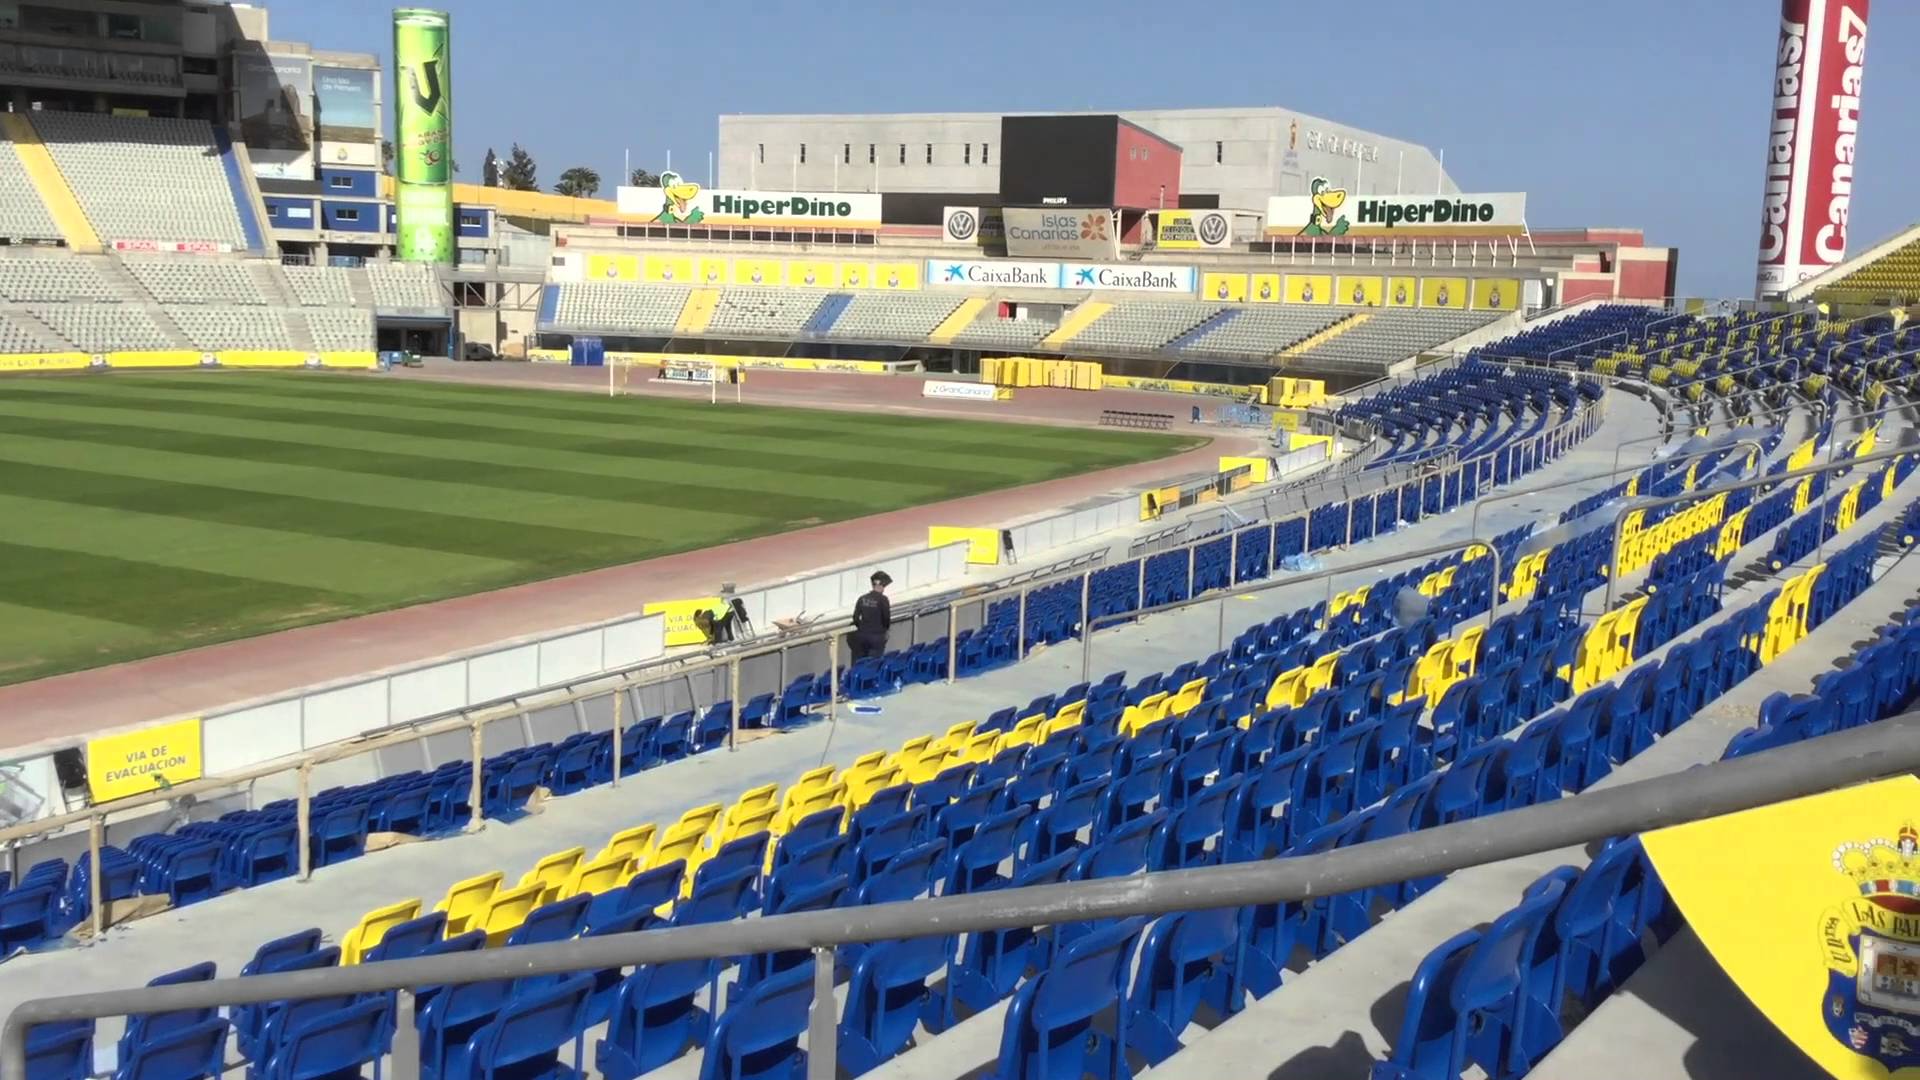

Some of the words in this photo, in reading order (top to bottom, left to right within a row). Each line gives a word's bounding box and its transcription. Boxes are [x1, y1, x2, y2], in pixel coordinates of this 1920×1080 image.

[1816, 5, 1867, 263] Canarias7
[713, 195, 852, 219] HiperDino
[1357, 199, 1494, 228] HiperDino
[1009, 226, 1079, 241] Canarias
[1041, 214, 1077, 231] Islas
[968, 265, 1047, 284] CaixaBank
[1099, 268, 1178, 289] CaixaBank
[126, 750, 147, 763] VIA
[151, 745, 168, 758] DE
[105, 755, 186, 782] EVACUACION
[1852, 902, 1886, 929] LAS
